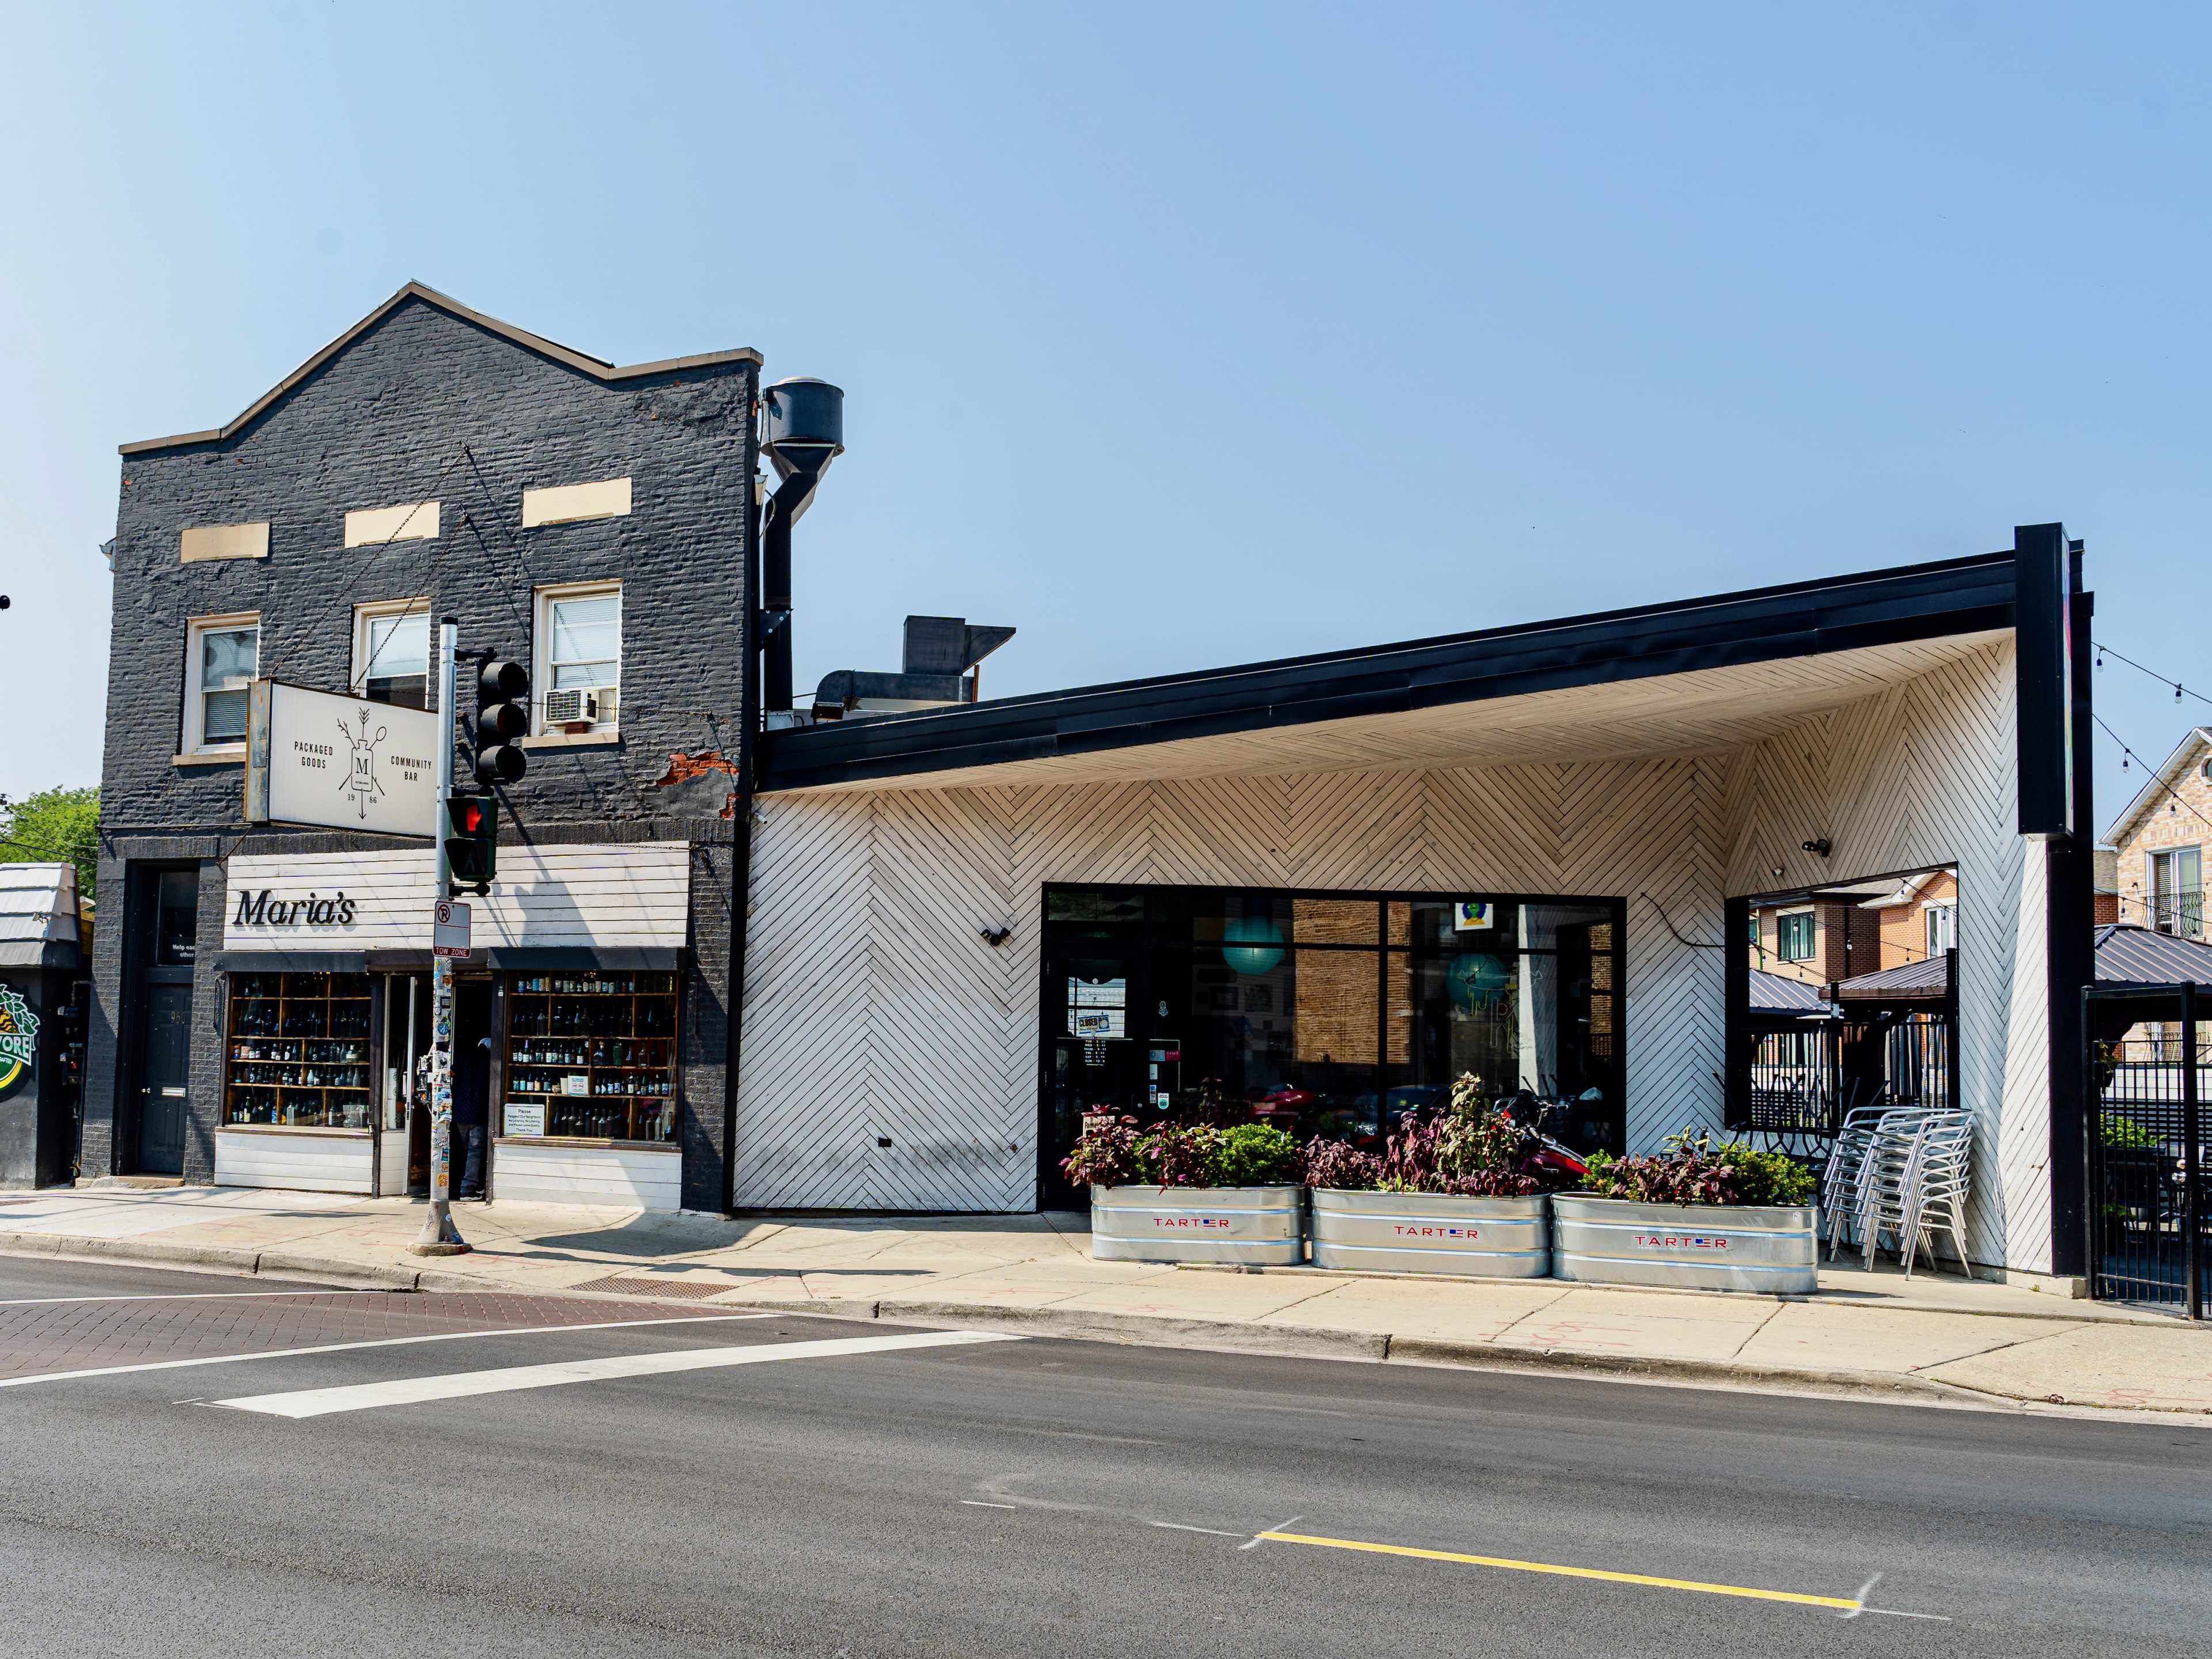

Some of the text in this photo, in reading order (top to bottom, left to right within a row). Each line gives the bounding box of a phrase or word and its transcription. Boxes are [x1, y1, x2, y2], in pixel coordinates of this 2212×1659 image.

[294, 741, 333, 756] PACKAGED
[301, 756, 326, 769] GOODS
[355, 757, 369, 775] M
[391, 755, 432, 770] COMMUNITY
[404, 771, 418, 782] BAR
[232, 889, 355, 925] Maria's
[435, 947, 468, 956] TOW ZONE
[1079, 1018, 1099, 1027] CLOSED
[1153, 1218, 1230, 1228] TARTER
[1393, 1225, 1479, 1239] TARTER
[1634, 1236, 1728, 1249] TARTER
